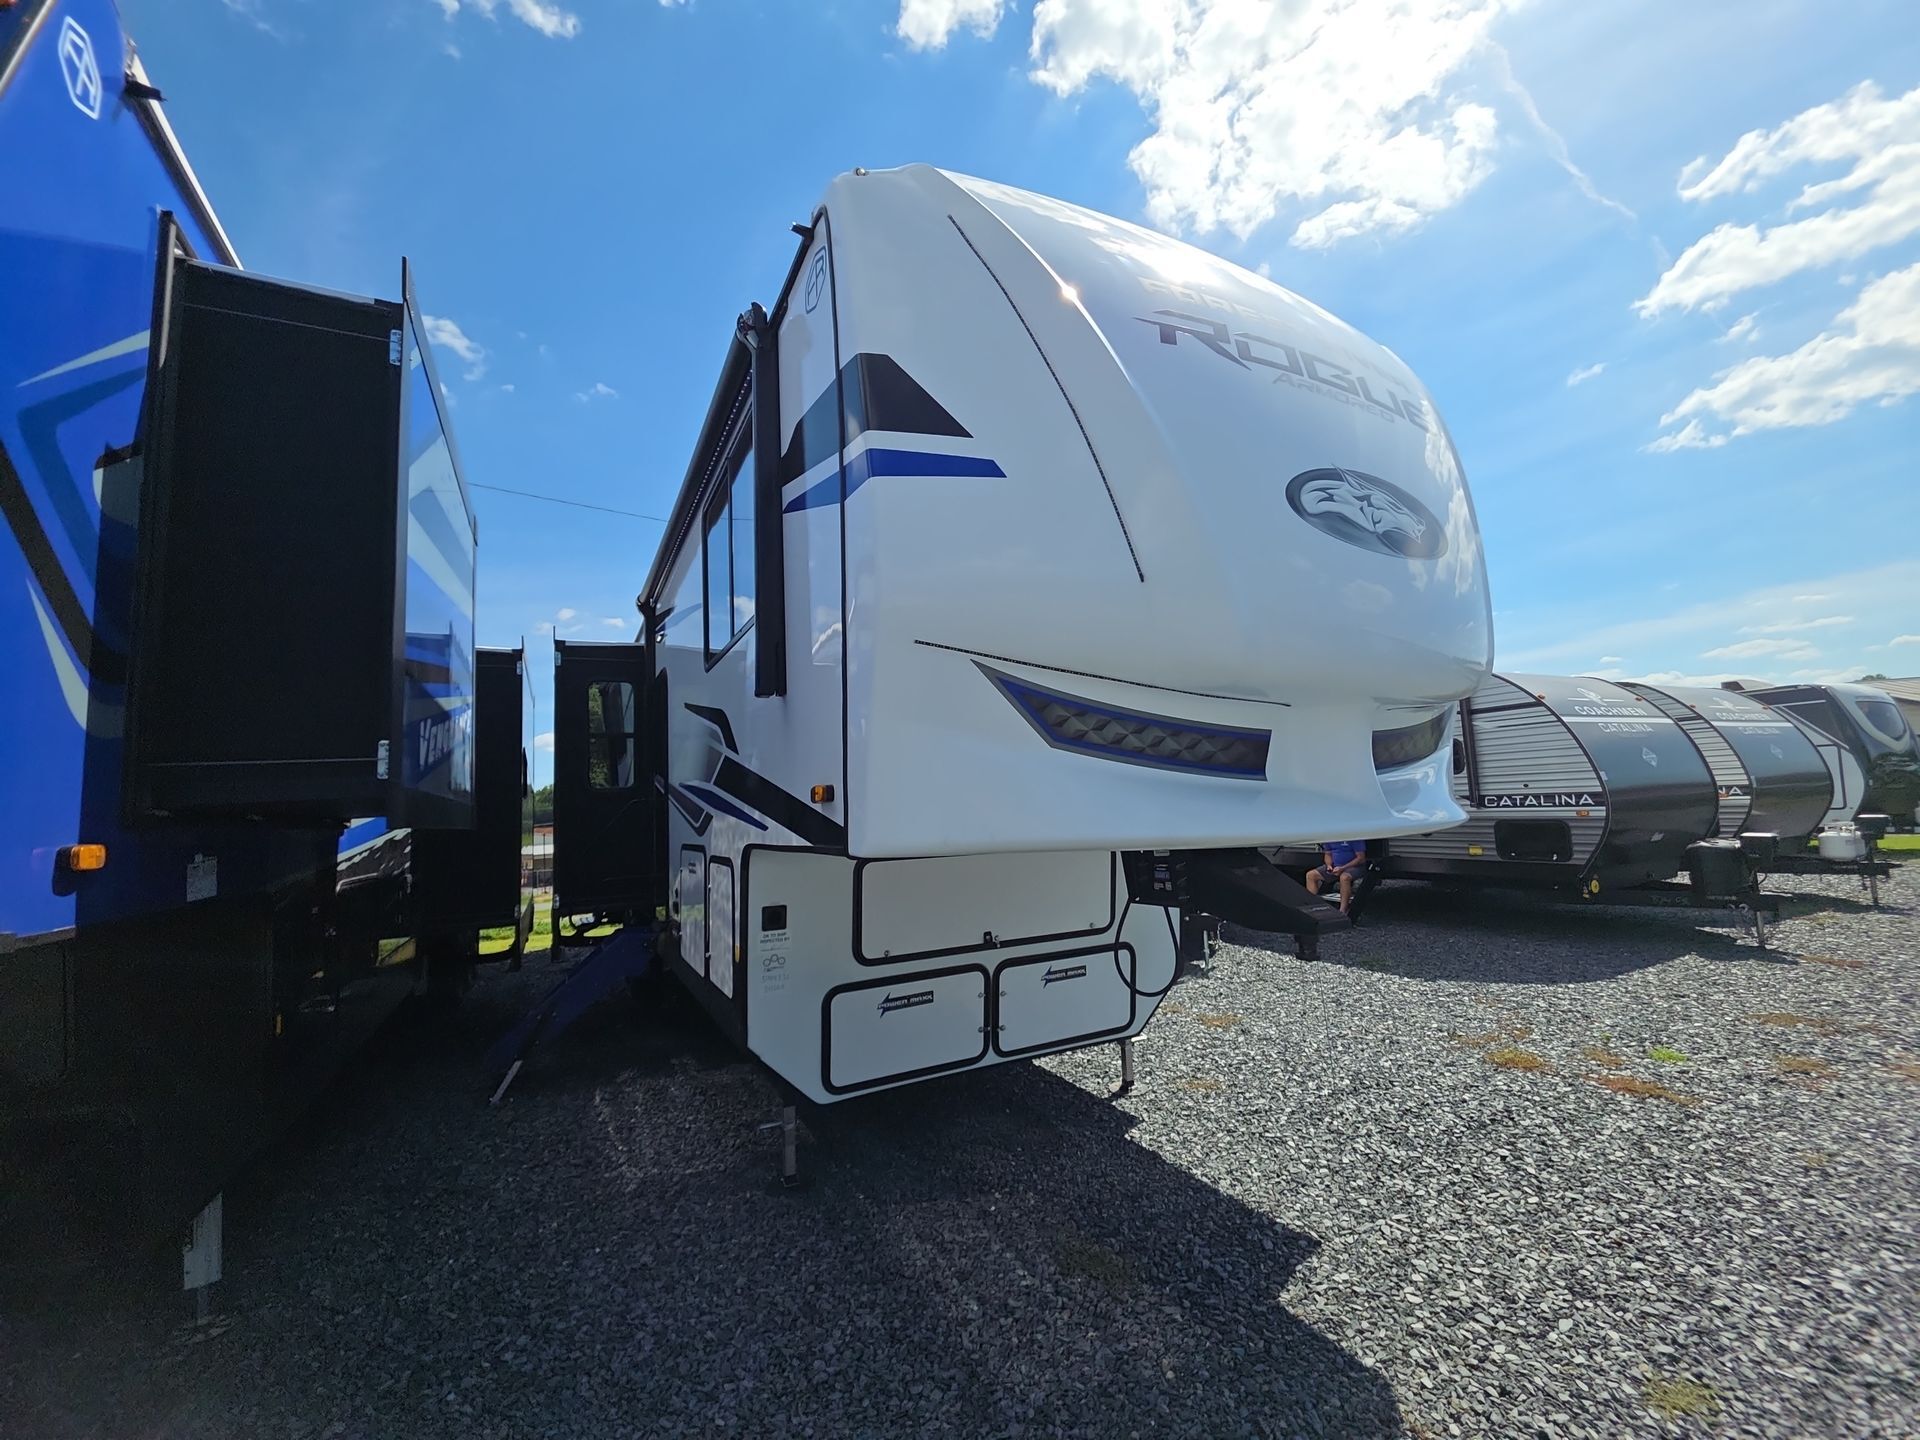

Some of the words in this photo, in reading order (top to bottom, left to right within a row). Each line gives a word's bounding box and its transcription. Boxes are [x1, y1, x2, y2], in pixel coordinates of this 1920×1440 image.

[1132, 309, 1430, 433] ROGUE
[1574, 705, 1648, 716] COACHMEN
[1598, 723, 1655, 733] CATALINA
[1484, 793, 1595, 808] CATALINA
